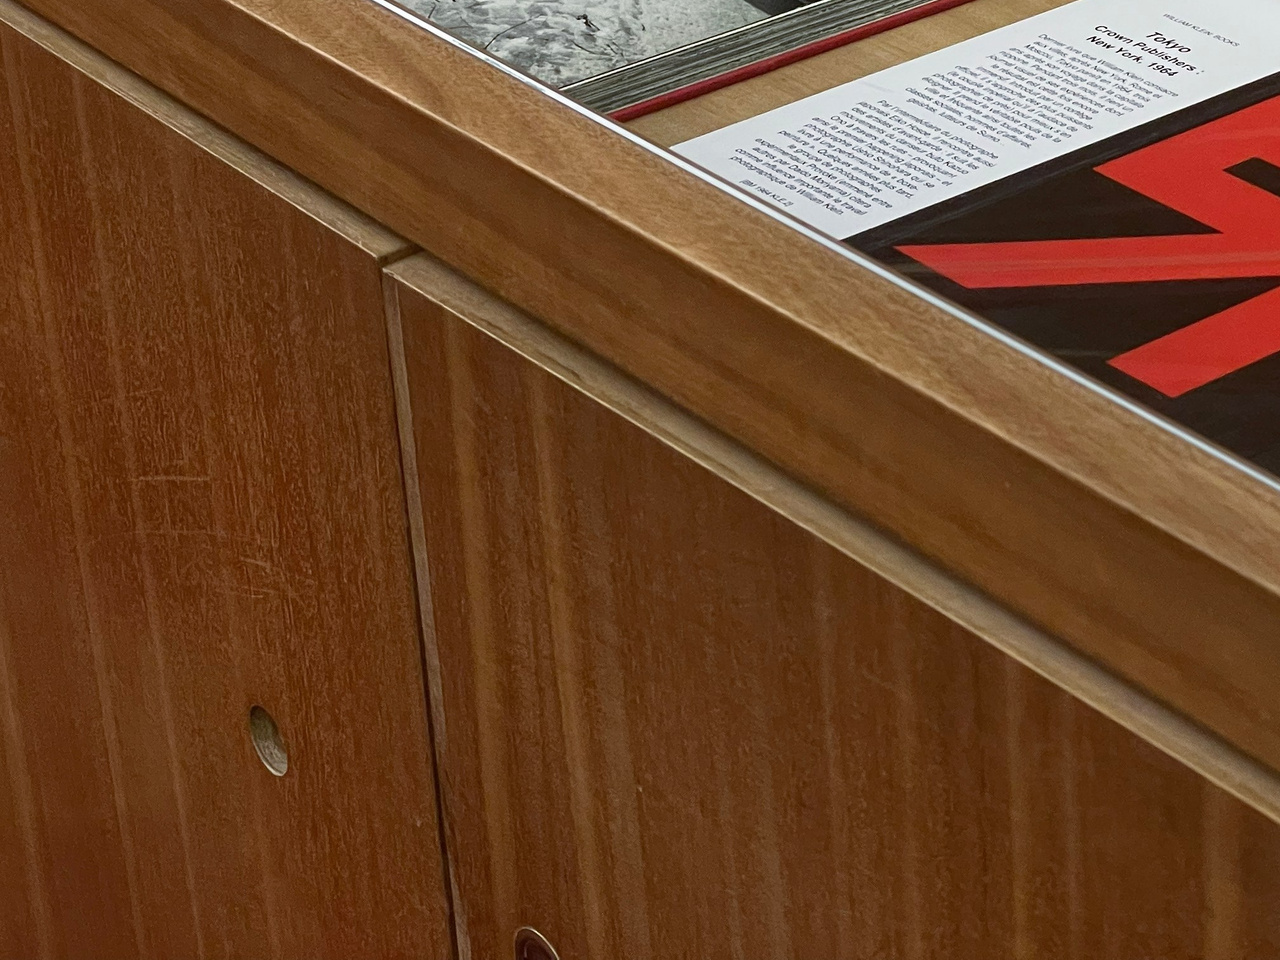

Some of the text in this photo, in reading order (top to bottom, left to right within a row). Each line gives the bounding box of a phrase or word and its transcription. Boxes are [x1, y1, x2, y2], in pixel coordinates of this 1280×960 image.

[1085, 35, 1116, 50] New
[1147, 62, 1179, 77] 1964
[1094, 25, 1134, 45] Crown
[1132, 41, 1197, 72] Publishers
[1145, 31, 1192, 53] Tokyo
